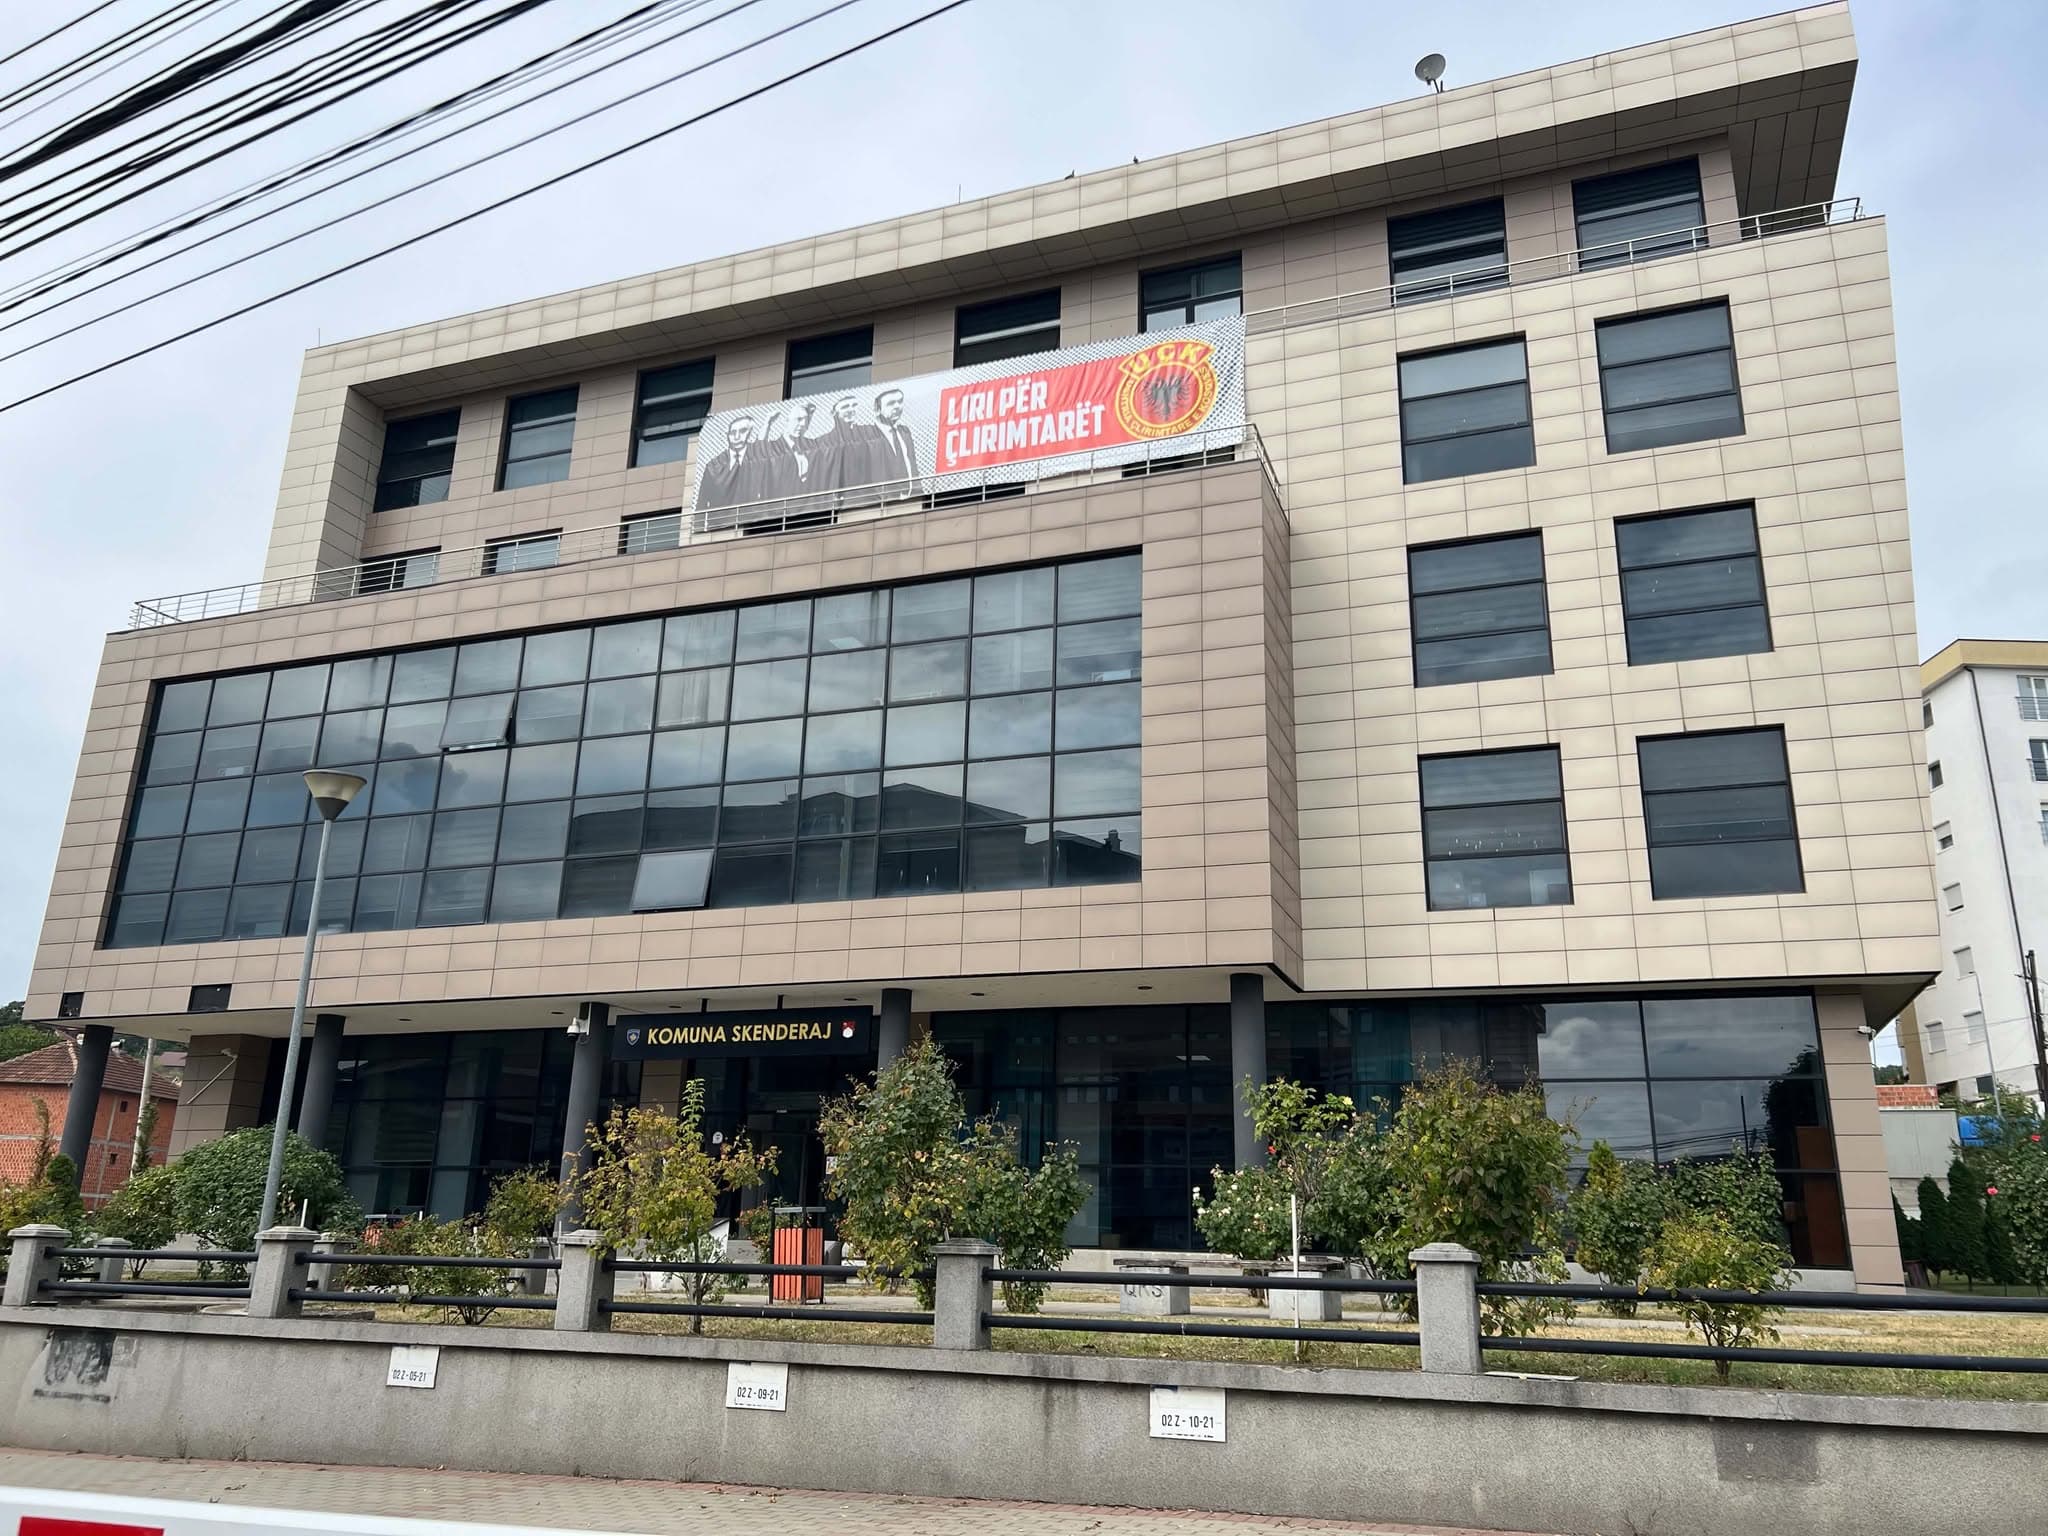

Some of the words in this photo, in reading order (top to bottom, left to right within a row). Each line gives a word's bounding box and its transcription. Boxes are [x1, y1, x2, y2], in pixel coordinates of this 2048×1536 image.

[947, 390, 994, 426] LIRI
[998, 378, 1048, 417] PËR
[945, 400, 1105, 467] ÇLIRIMTARËT
[647, 1026, 727, 1045] KOMUNA
[731, 1022, 832, 1042] SKENDERAJ
